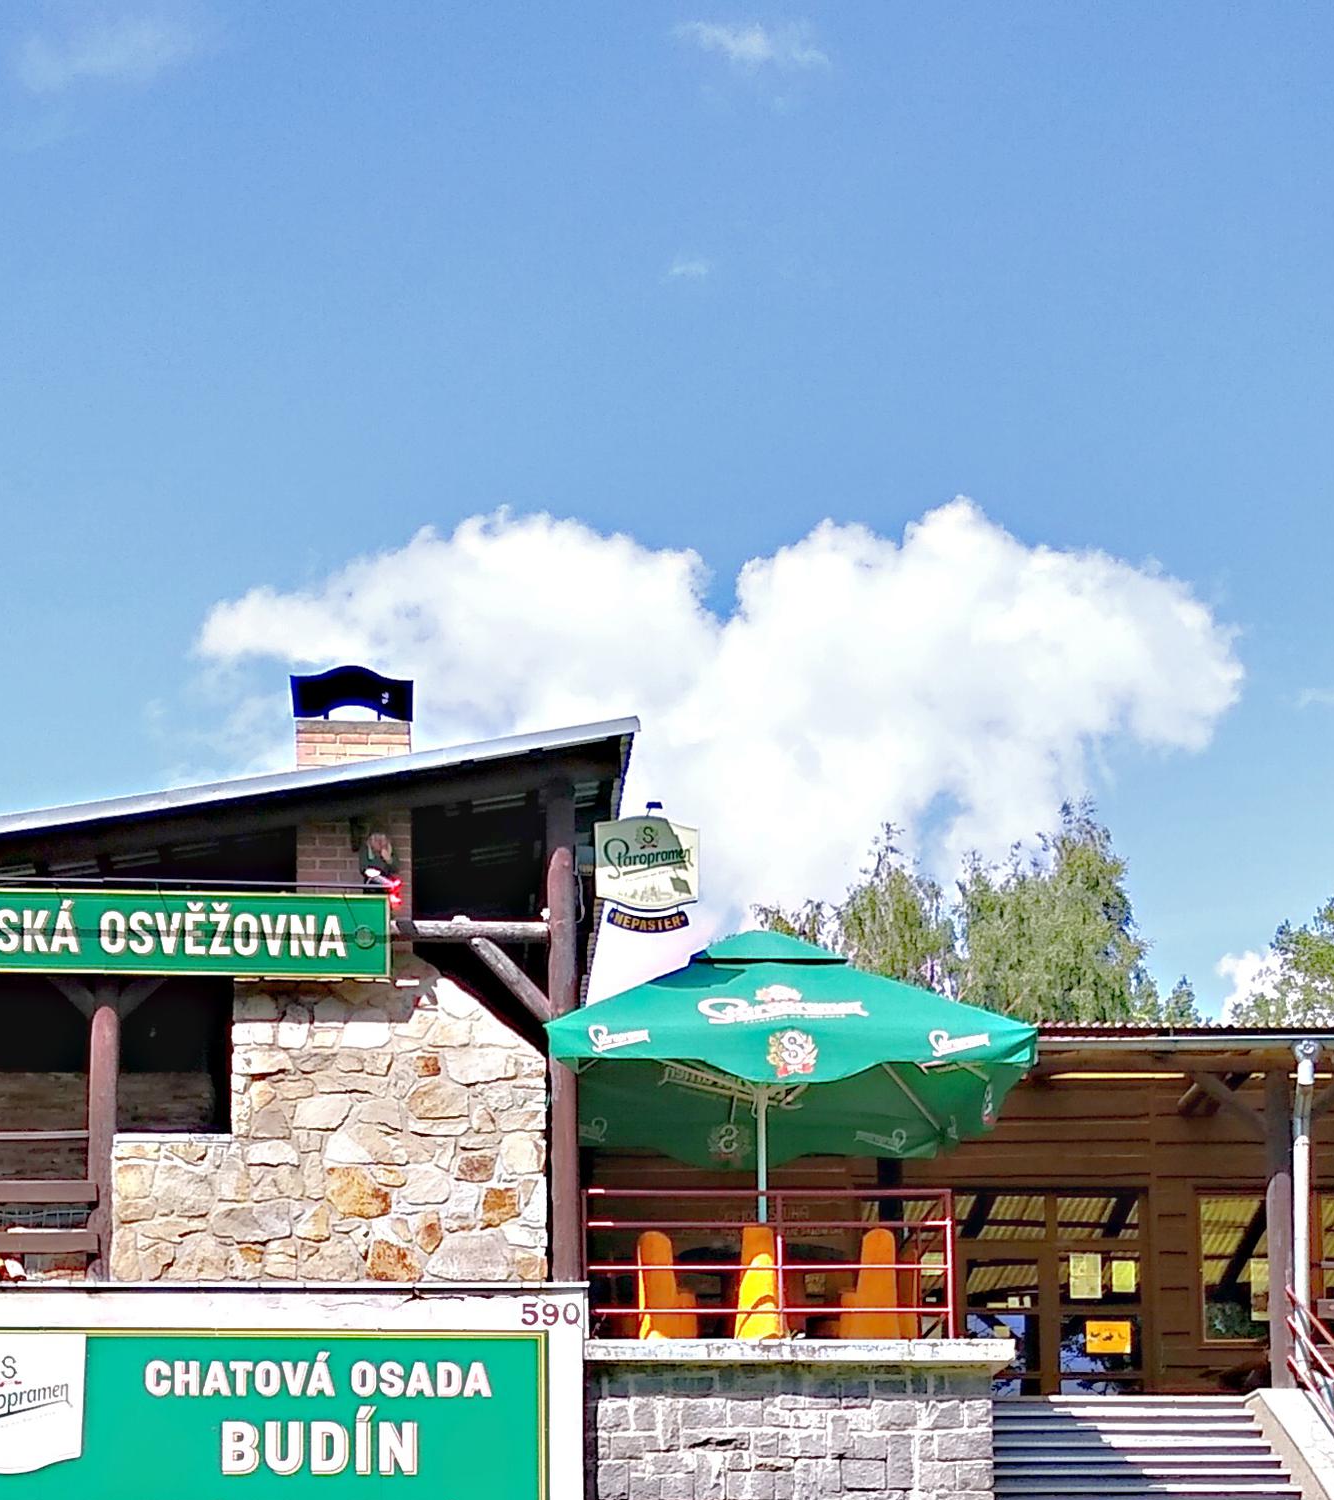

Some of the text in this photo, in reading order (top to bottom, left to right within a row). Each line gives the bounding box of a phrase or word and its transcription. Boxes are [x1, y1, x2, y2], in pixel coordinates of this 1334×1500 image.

[604, 838, 694, 879] Staropramen
[100, 902, 347, 958] OSVĚŽOVNA
[613, 911, 681, 931] NEPASTER
[521, 1302, 581, 1326] 590
[1, 1355, 18, 1379] S
[144, 1351, 492, 1398] CHATOVÁ OSADA
[220, 1405, 419, 1476] BUDÍN
